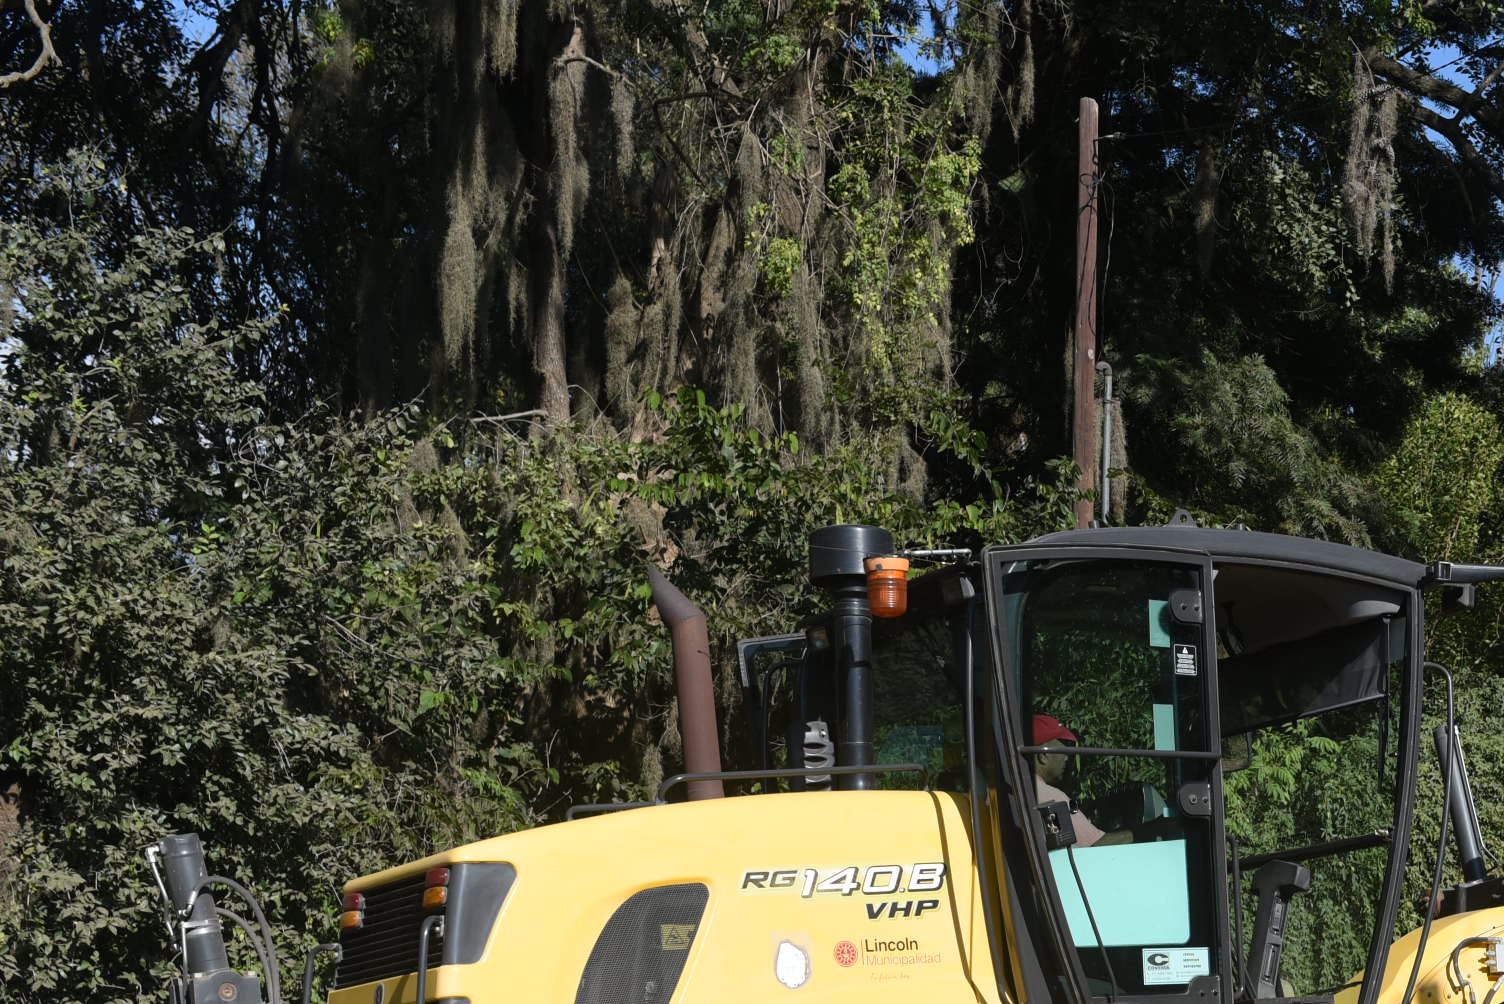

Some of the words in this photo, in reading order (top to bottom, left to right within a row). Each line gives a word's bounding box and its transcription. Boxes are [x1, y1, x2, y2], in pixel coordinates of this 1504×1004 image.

[866, 899, 939, 919] VHP
[865, 938, 918, 952] Lincoln
[866, 952, 942, 966] Municipalidad
